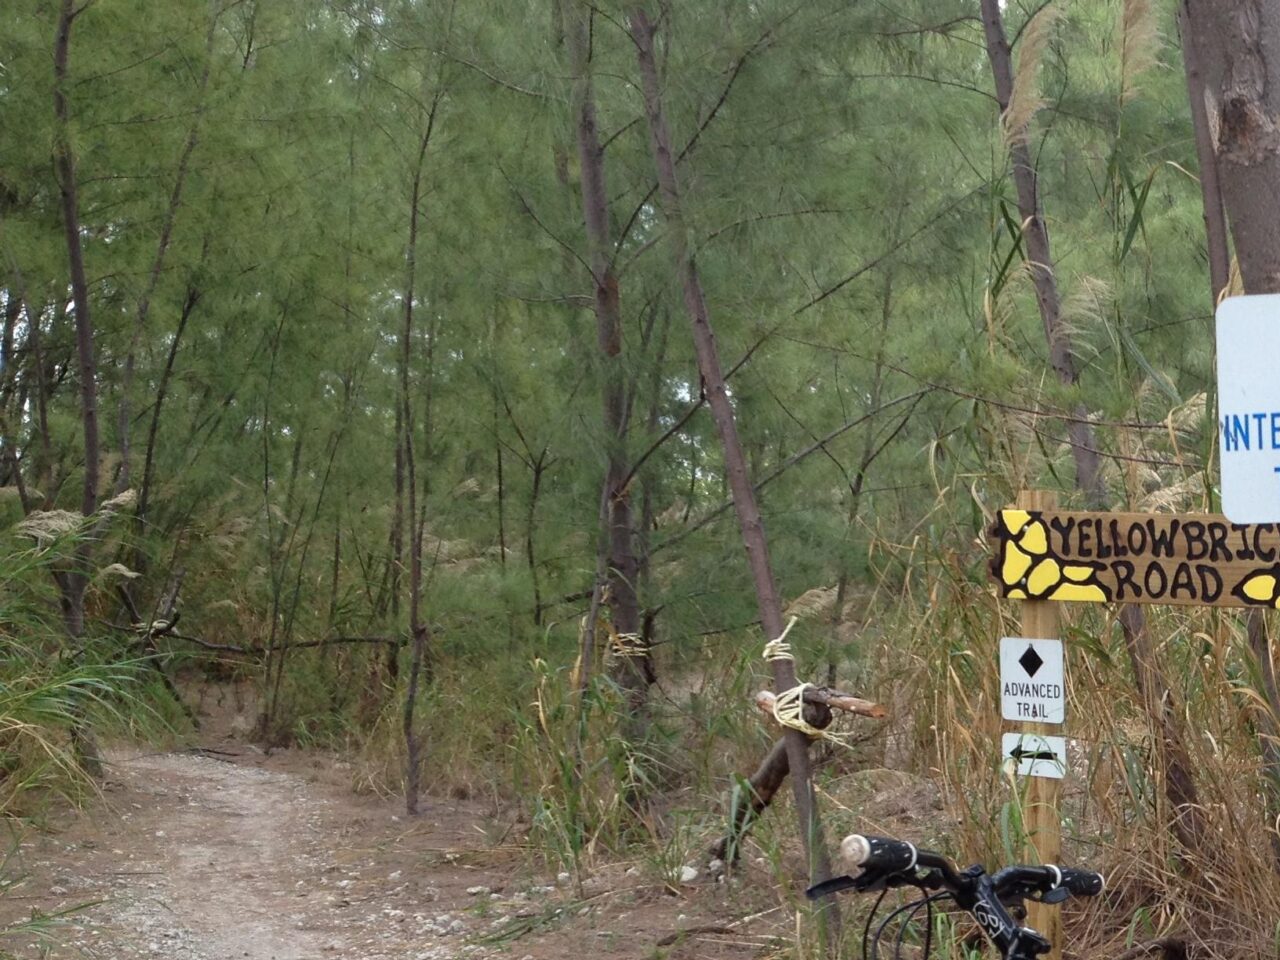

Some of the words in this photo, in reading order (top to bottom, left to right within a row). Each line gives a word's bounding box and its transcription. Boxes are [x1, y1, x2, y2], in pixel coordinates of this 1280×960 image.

[1110, 559, 1224, 602] ROAD
[1004, 682, 1061, 699] ADVANCED
[1017, 702, 1048, 718] TRAIL
